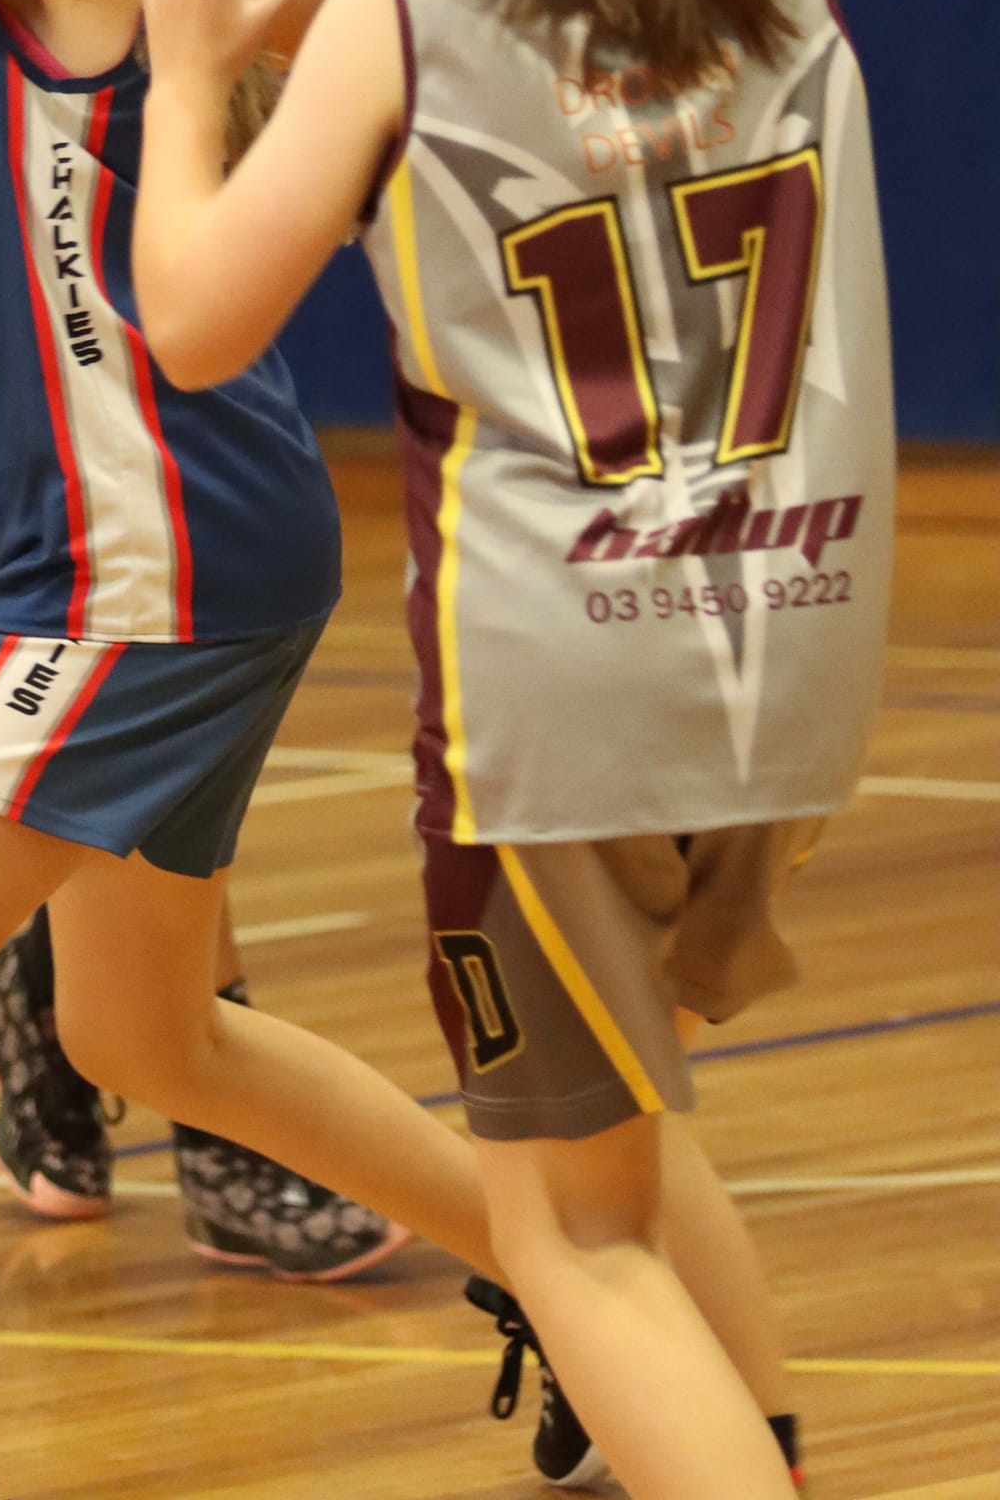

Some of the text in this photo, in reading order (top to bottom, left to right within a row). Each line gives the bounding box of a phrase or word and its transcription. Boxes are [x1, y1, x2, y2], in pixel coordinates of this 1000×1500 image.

[581, 102, 736, 175] DEVILS
[46, 141, 103, 366] CHALKIES
[501, 144, 825, 488] 17
[585, 570, 852, 623] 03 9450 9222
[432, 929, 525, 1075] D
